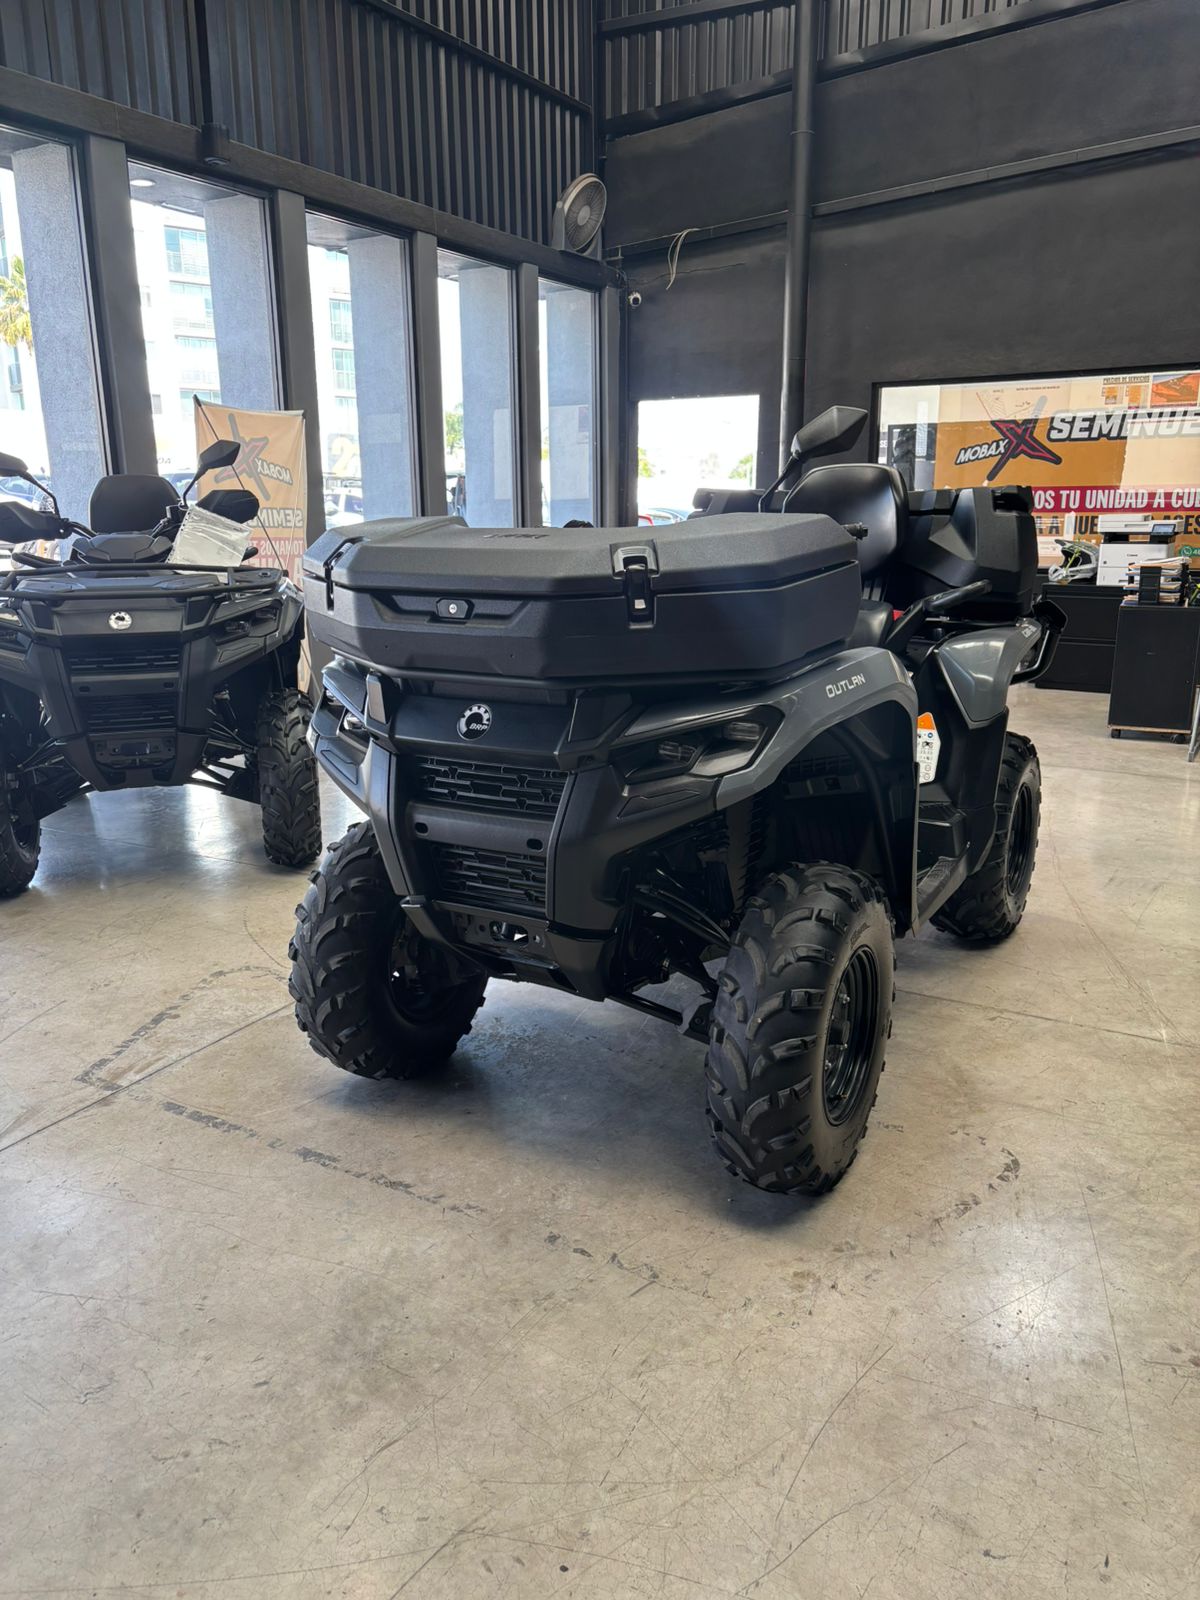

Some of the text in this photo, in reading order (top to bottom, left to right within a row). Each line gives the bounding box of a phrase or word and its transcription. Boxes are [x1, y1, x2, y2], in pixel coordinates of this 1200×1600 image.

[956, 438, 1009, 464] MOBAX
[1033, 490, 1055, 509] OS
[1060, 489, 1080, 509] TU
[1085, 488, 1149, 509] UNIDAD
[1153, 488, 1165, 508] A
[469, 722, 488, 731] BRP
